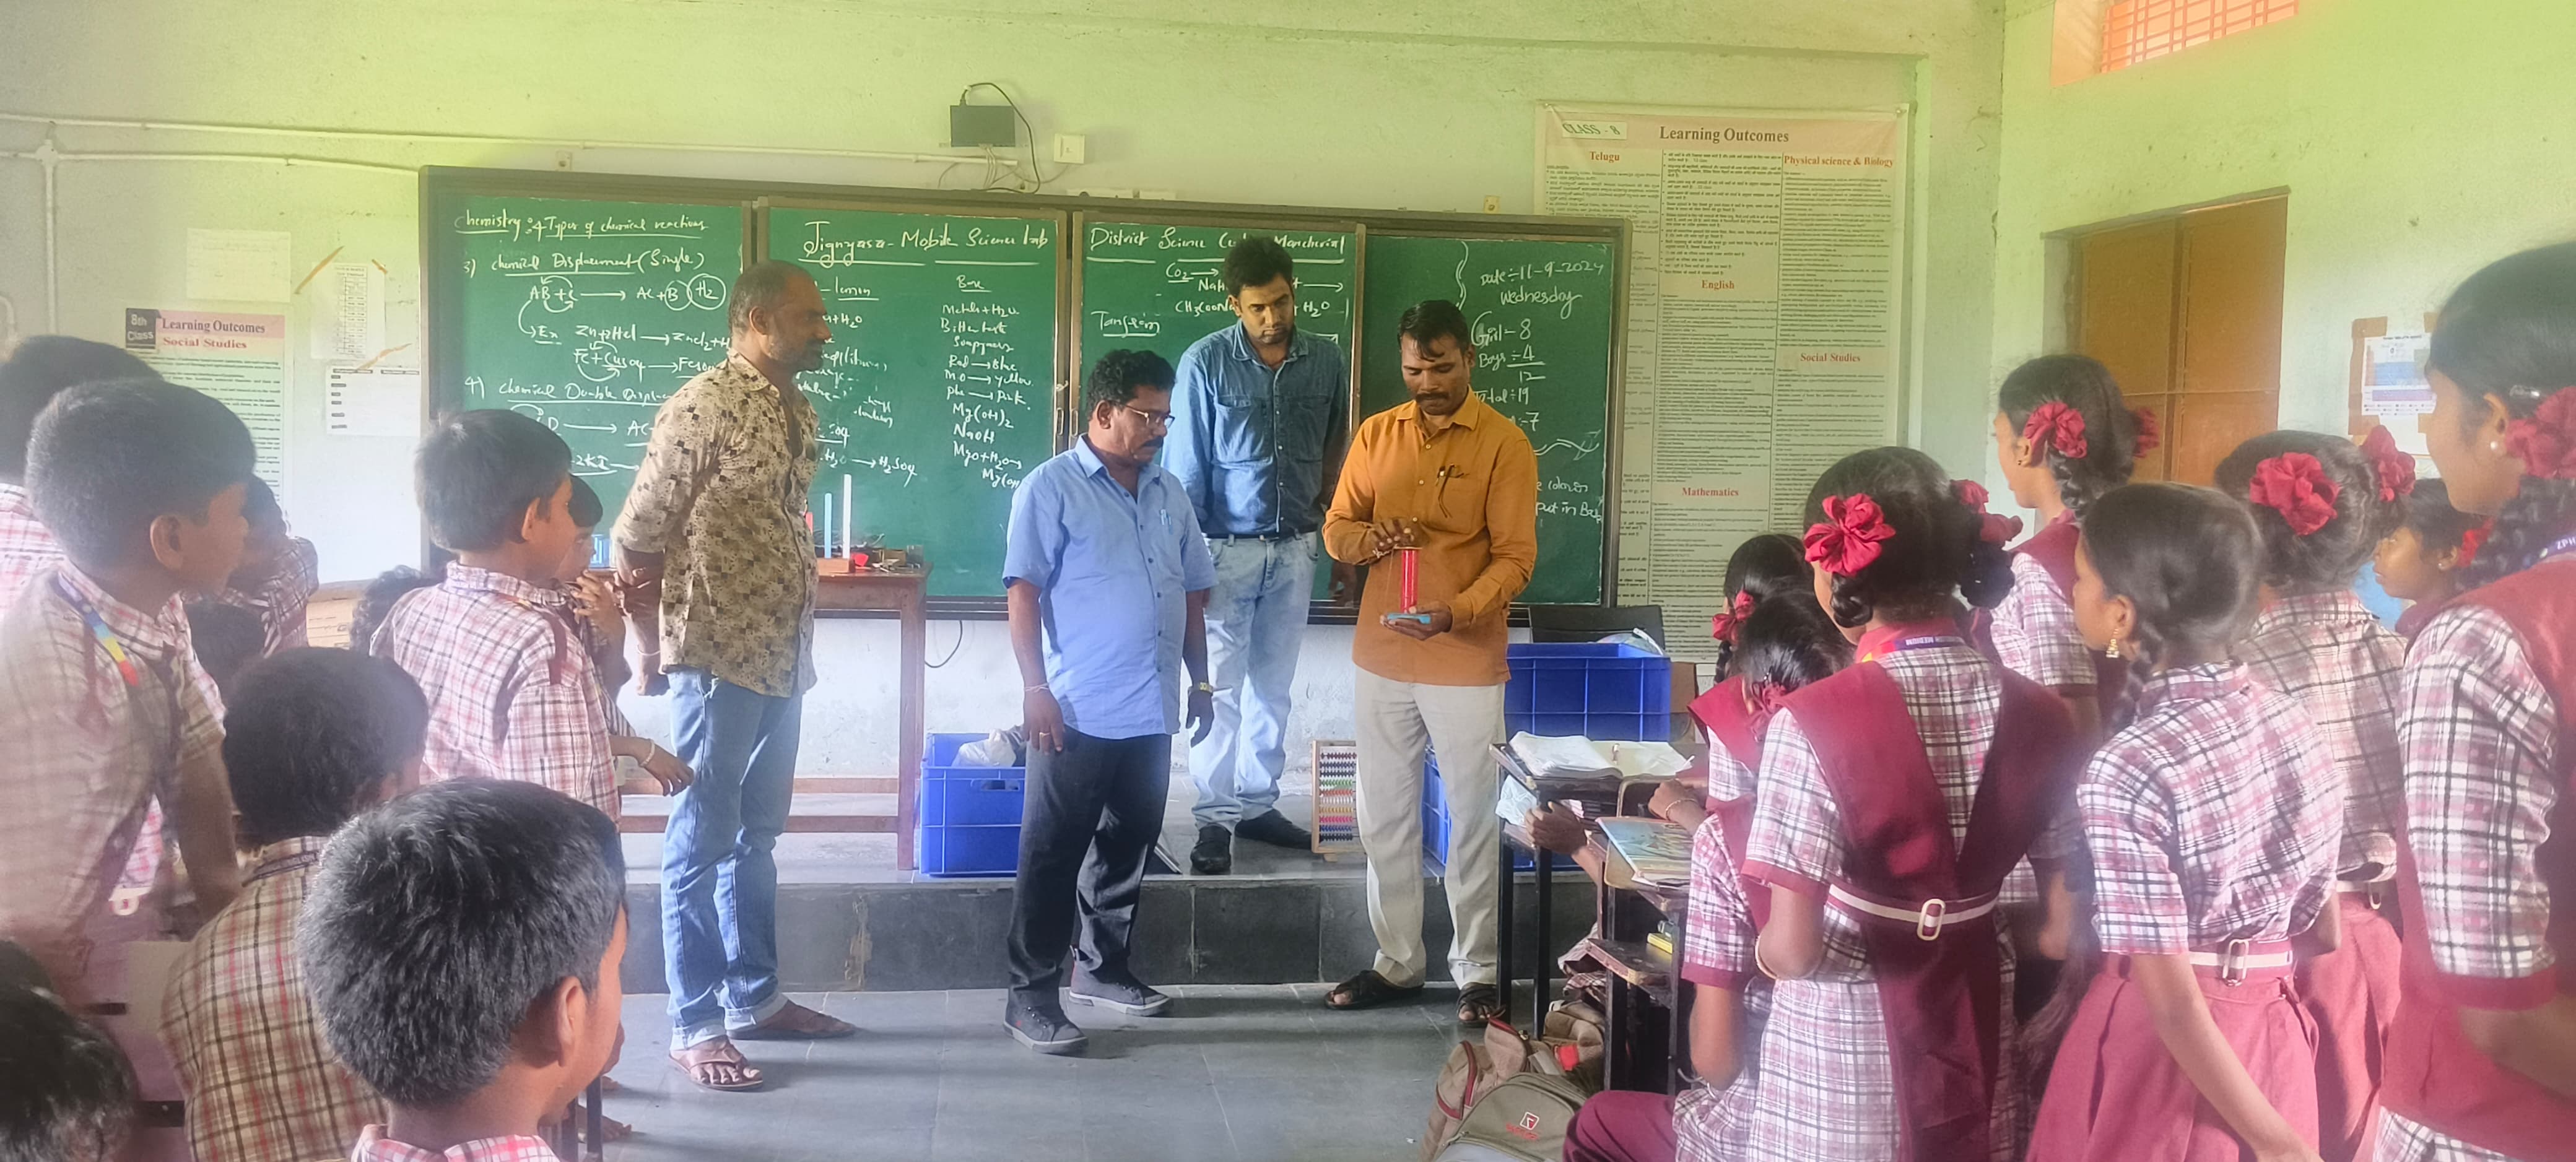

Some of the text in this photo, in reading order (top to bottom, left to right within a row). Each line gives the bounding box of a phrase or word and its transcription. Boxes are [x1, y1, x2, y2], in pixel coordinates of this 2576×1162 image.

[1562, 123, 1601, 134] CLASS
[1610, 125, 1621, 135] 8
[1660, 126, 1789, 144] Learning Outcomes
[1590, 151, 1620, 163] Telugu
[1783, 155, 1893, 167] Physical science & Biology
[901, 222, 959, 251] Mobile
[966, 227, 1016, 247] Science
[1090, 227, 1149, 251] District
[1158, 227, 1206, 249] Science
[1701, 280, 1734, 290] English
[131, 314, 147, 326] 8th
[162, 318, 266, 333] Learning Outcomes
[128, 331, 154, 341] Class
[163, 337, 248, 349] Social Studies
[1800, 353, 1861, 363] Social Studies
[1682, 487, 1739, 496] Mathematics
